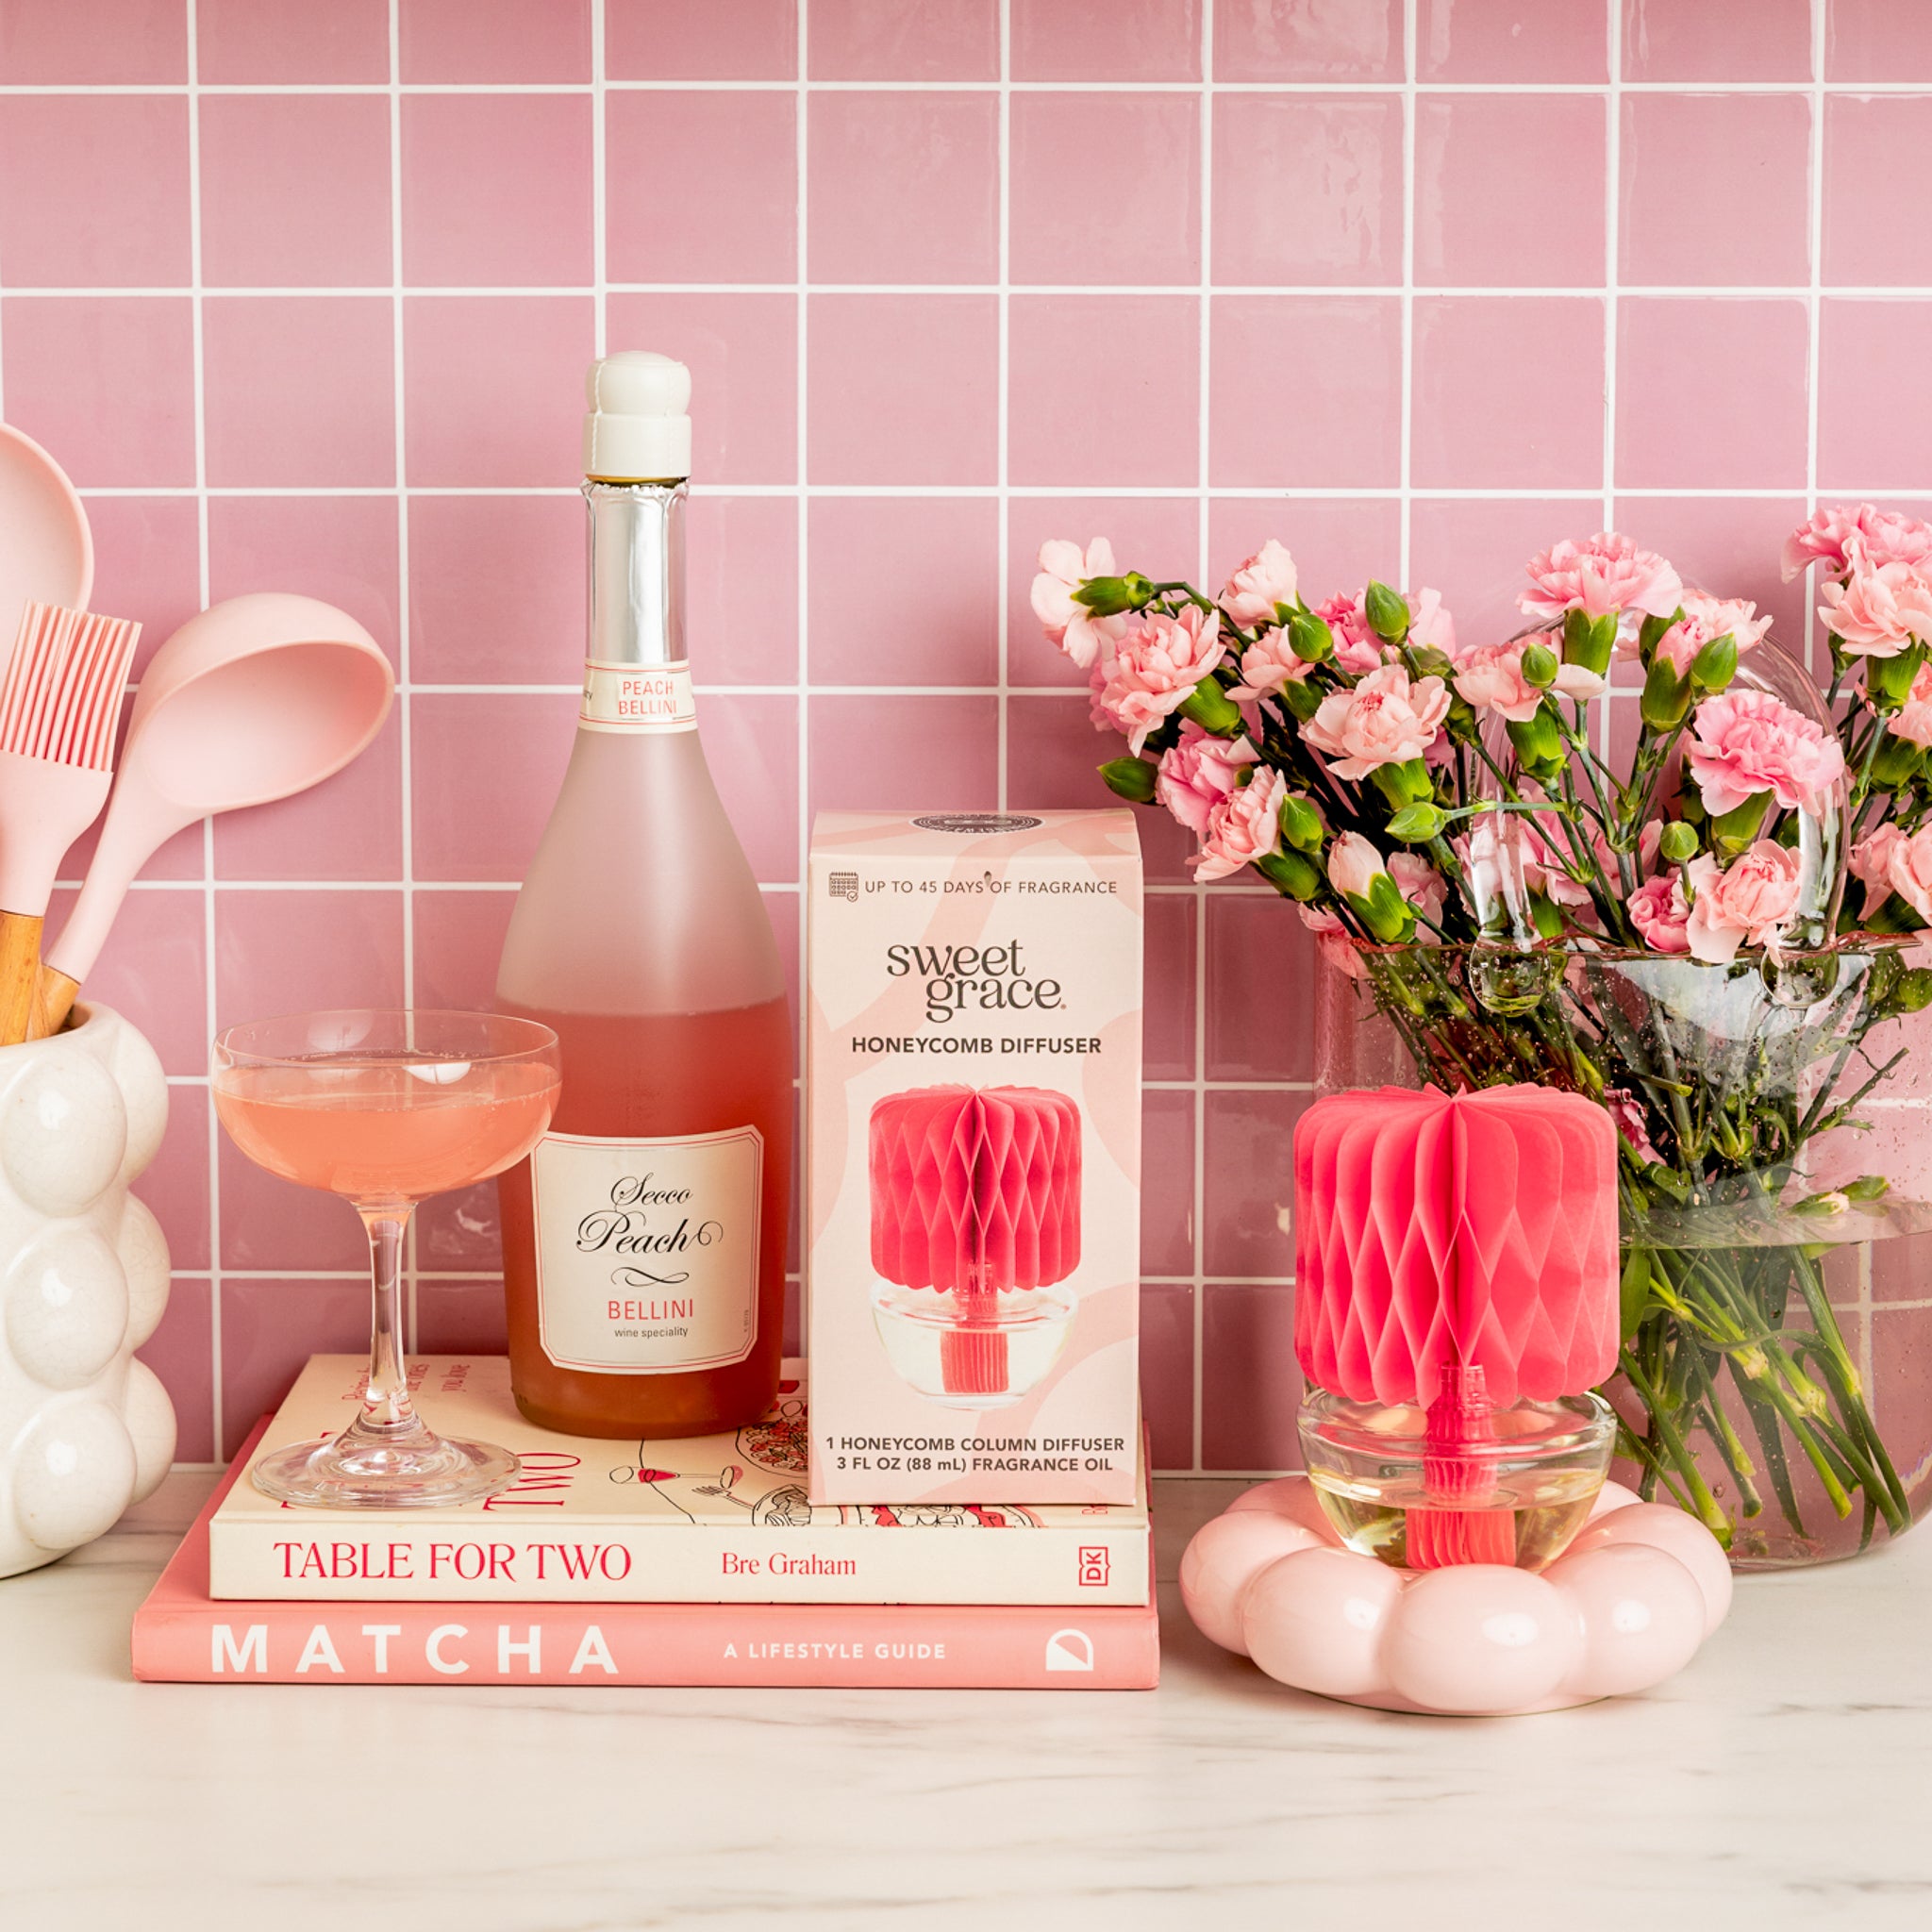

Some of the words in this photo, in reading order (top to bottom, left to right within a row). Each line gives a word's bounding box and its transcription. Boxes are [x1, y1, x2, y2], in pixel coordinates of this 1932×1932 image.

[623, 680, 675, 695] PEACH
[618, 699, 676, 715] BELLINI
[866, 881, 886, 892] UP
[892, 881, 912, 892] TO
[920, 881, 937, 892] 45
[944, 881, 983, 892] DAYS
[990, 881, 1011, 893] OF
[1020, 881, 1117, 893] FRAGRANCE
[887, 939, 1026, 976] sweet
[853, 1037, 992, 1053] HONEYCOMB
[1002, 1038, 1101, 1054] DIFFUSER
[610, 1172, 693, 1207] Secco
[577, 1210, 723, 1253] Peach
[608, 1298, 693, 1320] BELLINI
[614, 1329, 639, 1338] wine
[642, 1327, 688, 1339] speciality
[826, 1437, 833, 1449] 1
[841, 1438, 955, 1450] HONEYCOMB
[961, 1439, 1036, 1451] COLUMN
[1043, 1439, 1124, 1451] DIFFUSER
[838, 1457, 845, 1469] 3
[853, 1457, 871, 1470] FL
[877, 1457, 900, 1470] OZ
[908, 1458, 931, 1472] (88
[938, 1458, 966, 1473] mL)
[974, 1458, 1078, 1471] FRAGRANCE
[1085, 1458, 1112, 1471] OIL
[274, 1542, 413, 1578] TABLE
[430, 1543, 515, 1581] FOR
[527, 1544, 631, 1580] TWO
[723, 1553, 759, 1574] Bre
[769, 1553, 855, 1574] Graham
[1087, 1553, 1101, 1580] DK
[211, 1624, 618, 1674] MATCHA
[724, 1643, 738, 1657] A
[749, 1643, 863, 1658] LIFESTYLE
[875, 1643, 944, 1658] GUIDE
